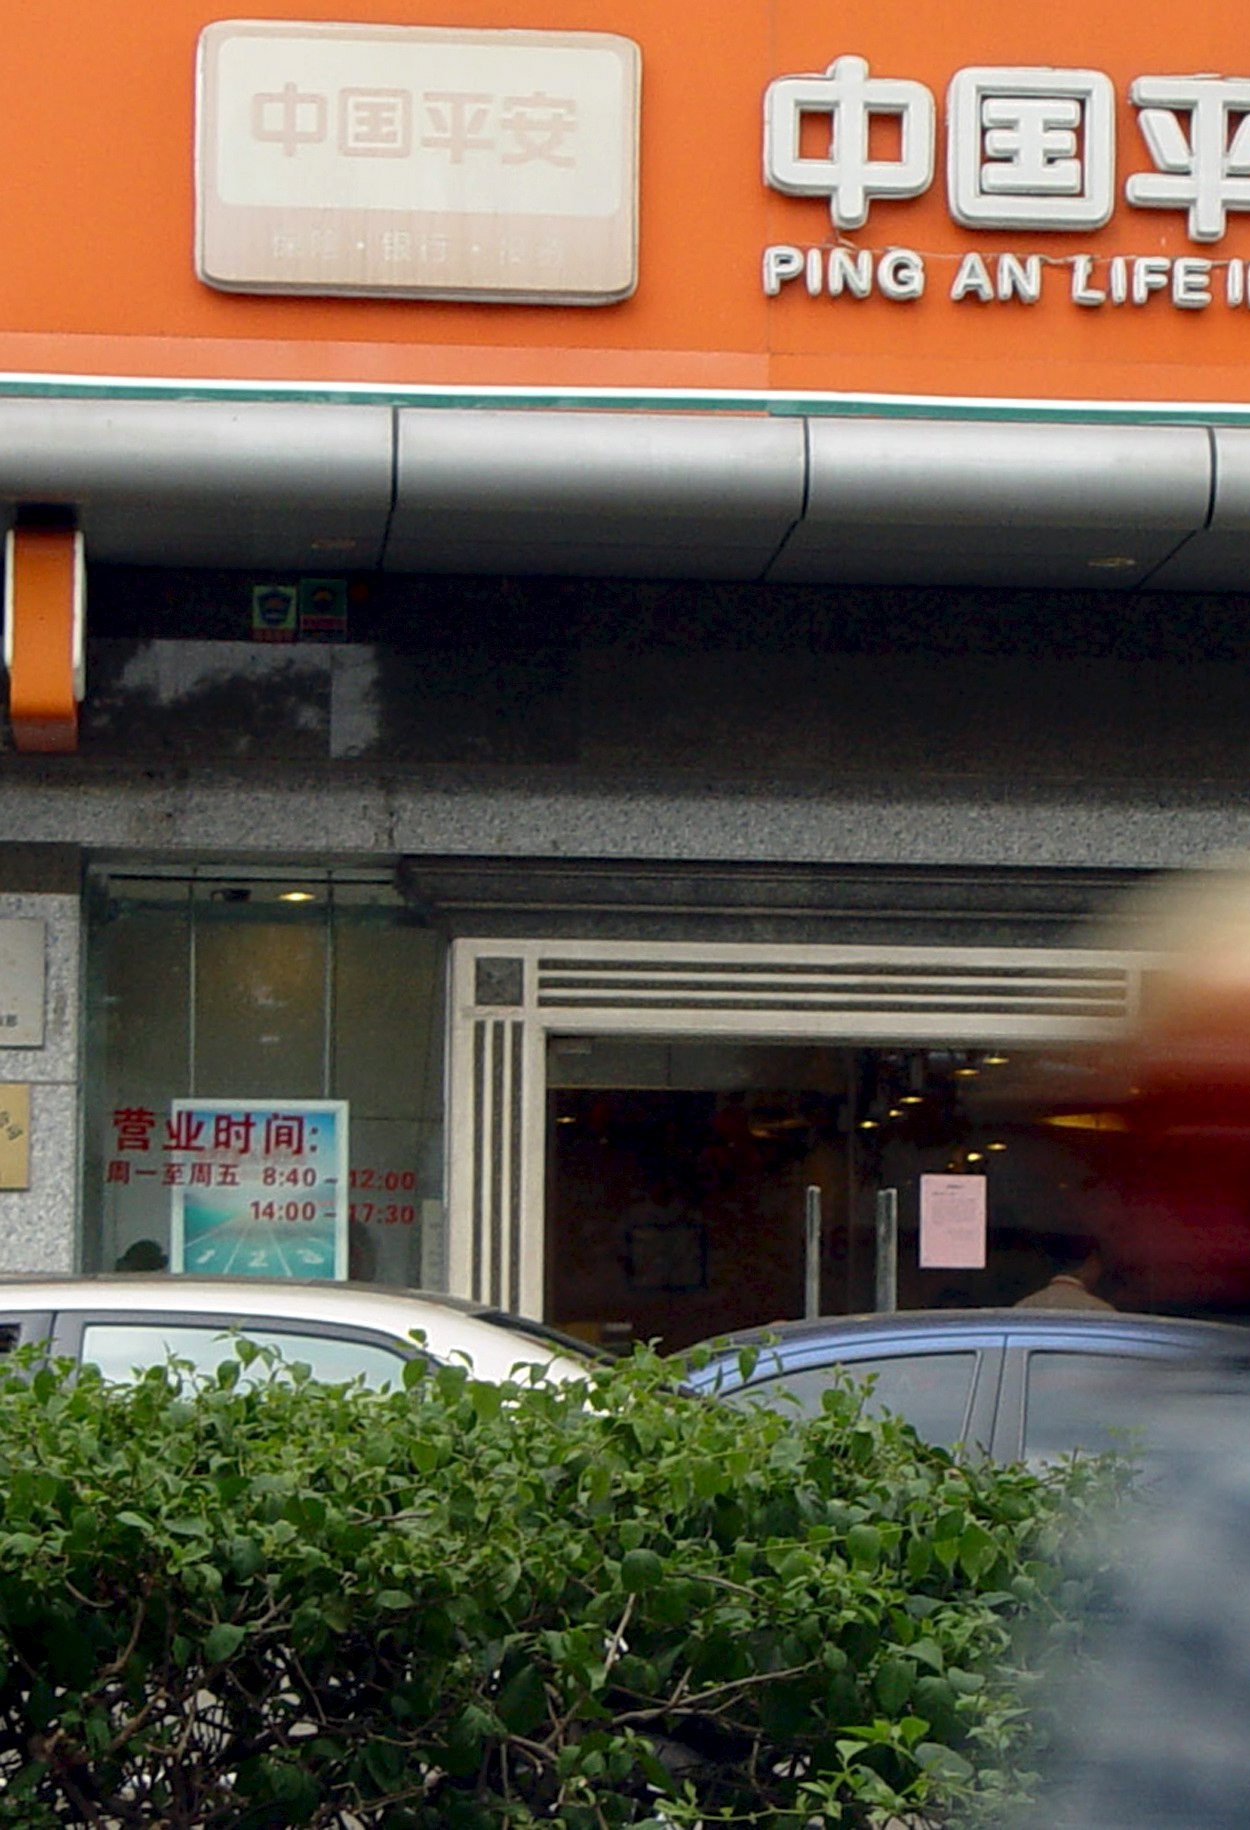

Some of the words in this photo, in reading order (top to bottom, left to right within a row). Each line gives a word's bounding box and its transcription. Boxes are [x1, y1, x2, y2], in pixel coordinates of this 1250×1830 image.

[251, 81, 578, 170] 中国平安
[763, 244, 925, 300] PING
[950, 251, 1041, 304] AN
[1071, 254, 1213, 309] LIFE
[112, 1106, 319, 1155] 营业时间:
[106, 1160, 241, 1188] 周一至周五
[262, 1166, 316, 1187] 8:40
[349, 1169, 417, 1191] 12:00
[250, 1201, 316, 1222] 14:00
[349, 1203, 416, 1225] 17:30
